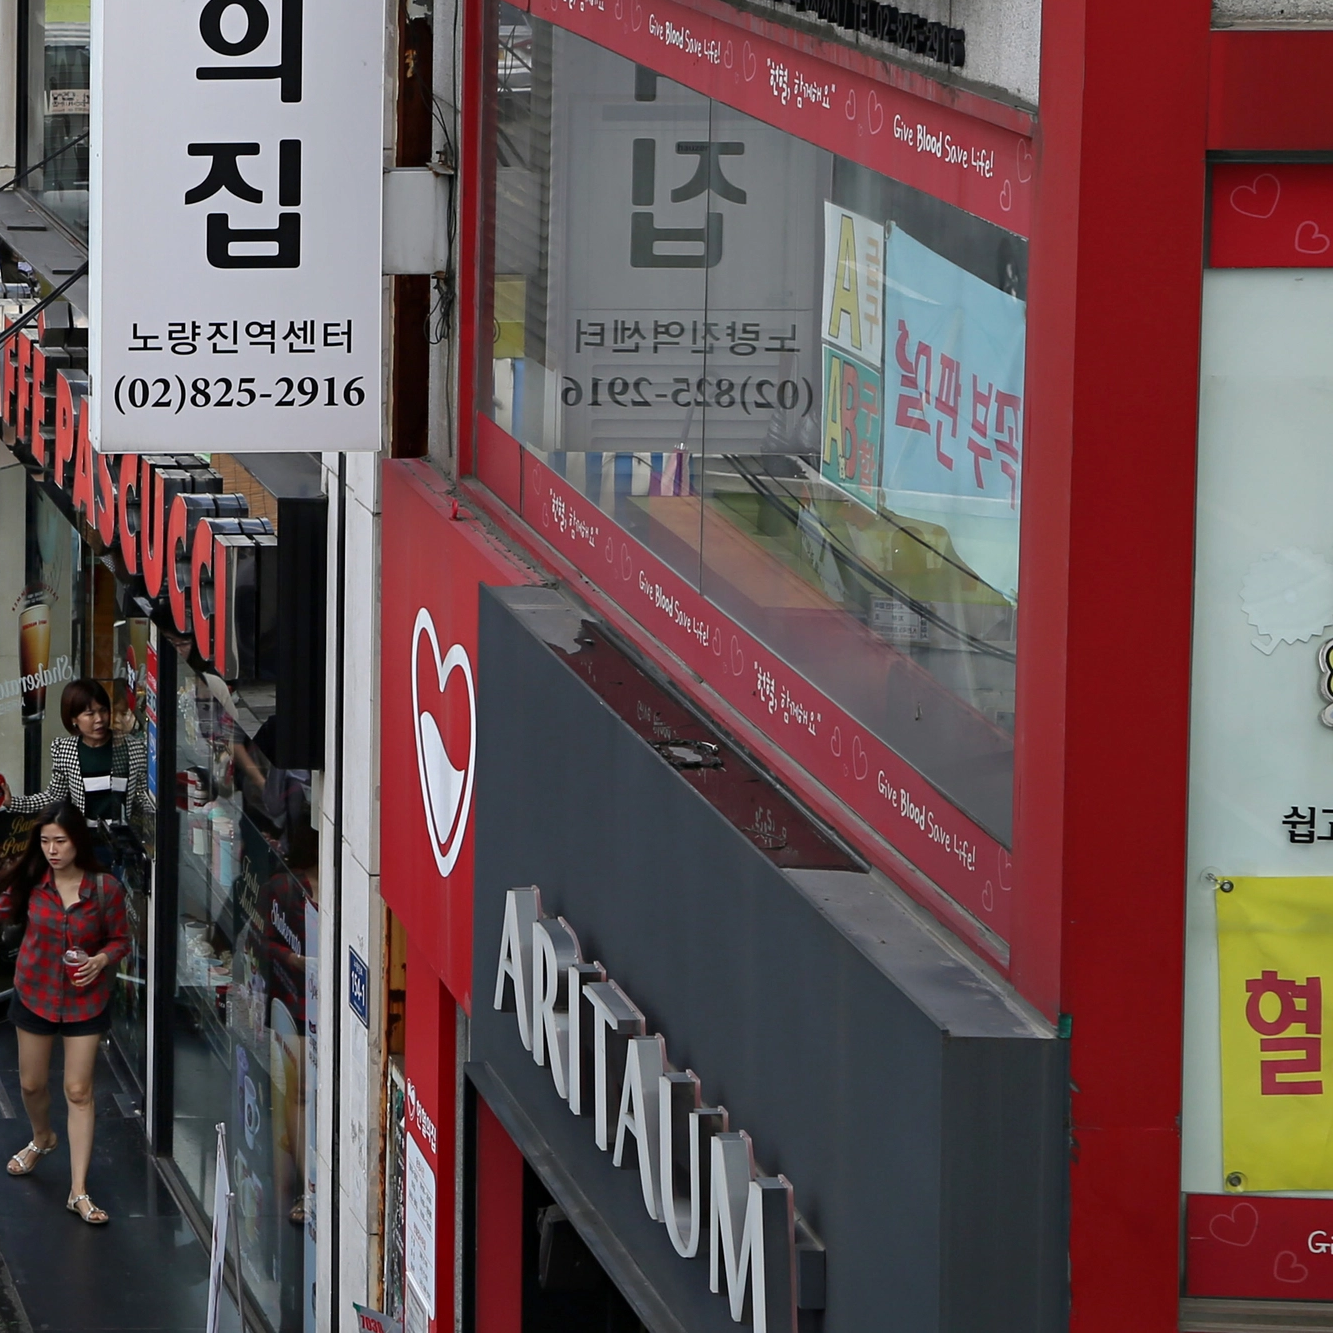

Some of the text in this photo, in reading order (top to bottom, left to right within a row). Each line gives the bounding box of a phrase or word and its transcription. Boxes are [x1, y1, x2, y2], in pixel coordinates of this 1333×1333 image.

[648, 13, 721, 64] Give Blood Save Life!
[892, 114, 995, 178] Give Blood Save Life!
[127, 318, 355, 357] 노량진역센터
[113, 373, 367, 416] (02)825-2916
[638, 569, 710, 647] Give Blood Save Life!
[877, 770, 977, 872] Give Blood Save Life!
[351, 972, 366, 1006] 154-1
[1244, 970, 1325, 1098] 혈
[416, 1099, 437, 1155] 헌혈의집
[494, 887, 791, 1333] ARITAUM
